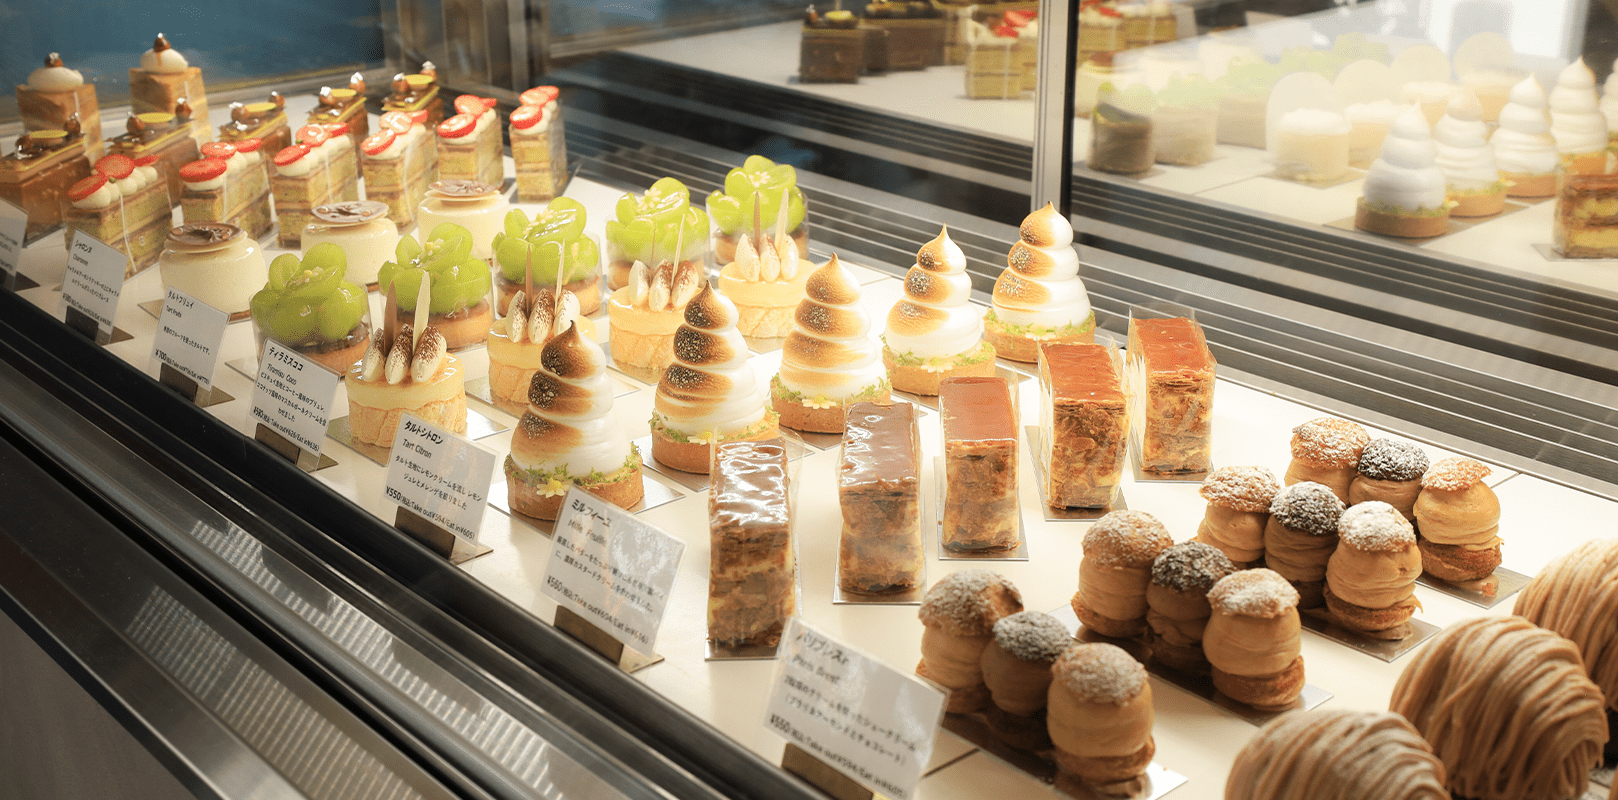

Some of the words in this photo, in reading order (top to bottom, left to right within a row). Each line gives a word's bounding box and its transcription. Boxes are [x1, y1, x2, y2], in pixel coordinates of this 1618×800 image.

[167, 290, 195, 309] タルトフリュイ
[268, 346, 304, 372] ティラミスココ
[285, 374, 298, 385] Coco
[277, 406, 296, 422] わせました
[405, 420, 443, 445] タルトシトロン
[403, 439, 414, 449] Tart
[416, 445, 432, 457] Citron
[404, 472, 467, 510] ジュレとメレンゲを絞りました
[468, 491, 482, 502] レモン
[572, 499, 612, 527] ミルフィーユ
[568, 519, 583, 532] Mille
